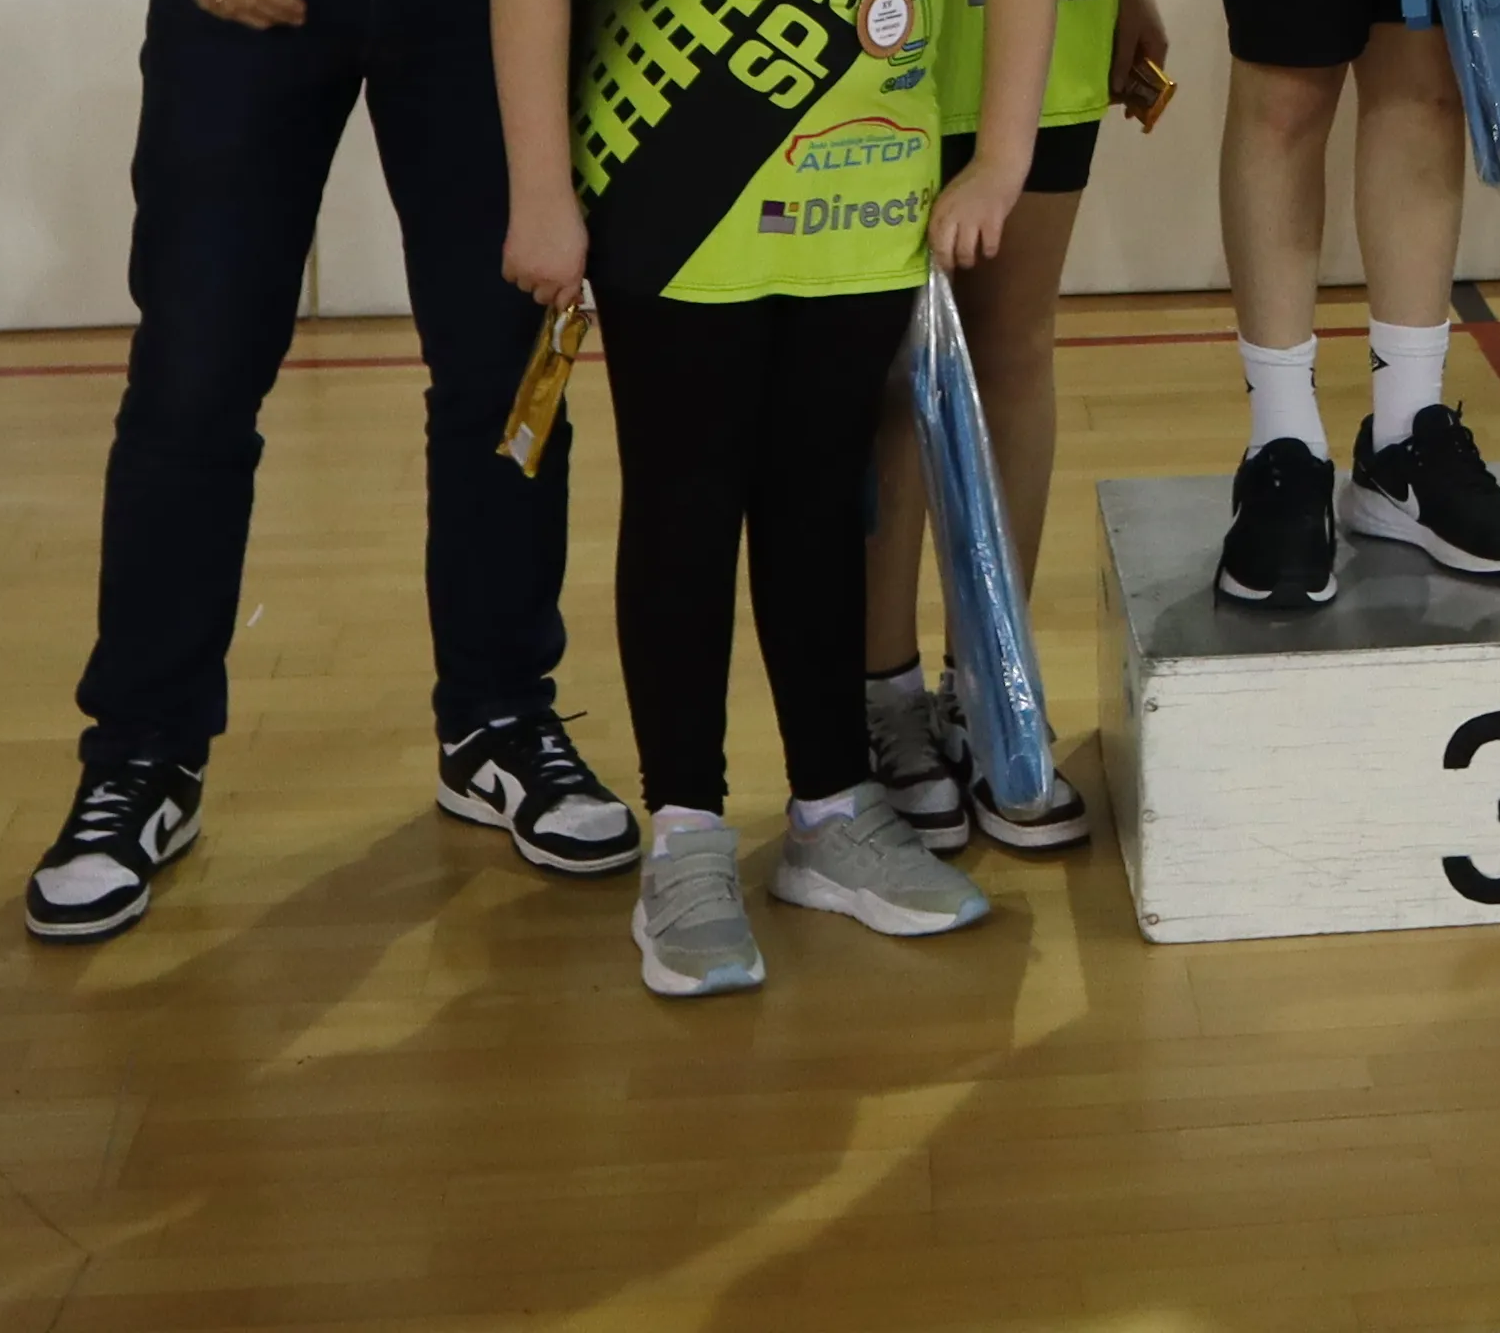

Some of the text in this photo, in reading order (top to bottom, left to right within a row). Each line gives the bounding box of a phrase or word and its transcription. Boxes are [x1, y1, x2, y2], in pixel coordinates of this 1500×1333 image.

[728, 2, 830, 110] SP
[796, 136, 923, 173] ALLTOP
[802, 193, 919, 236] Direct
